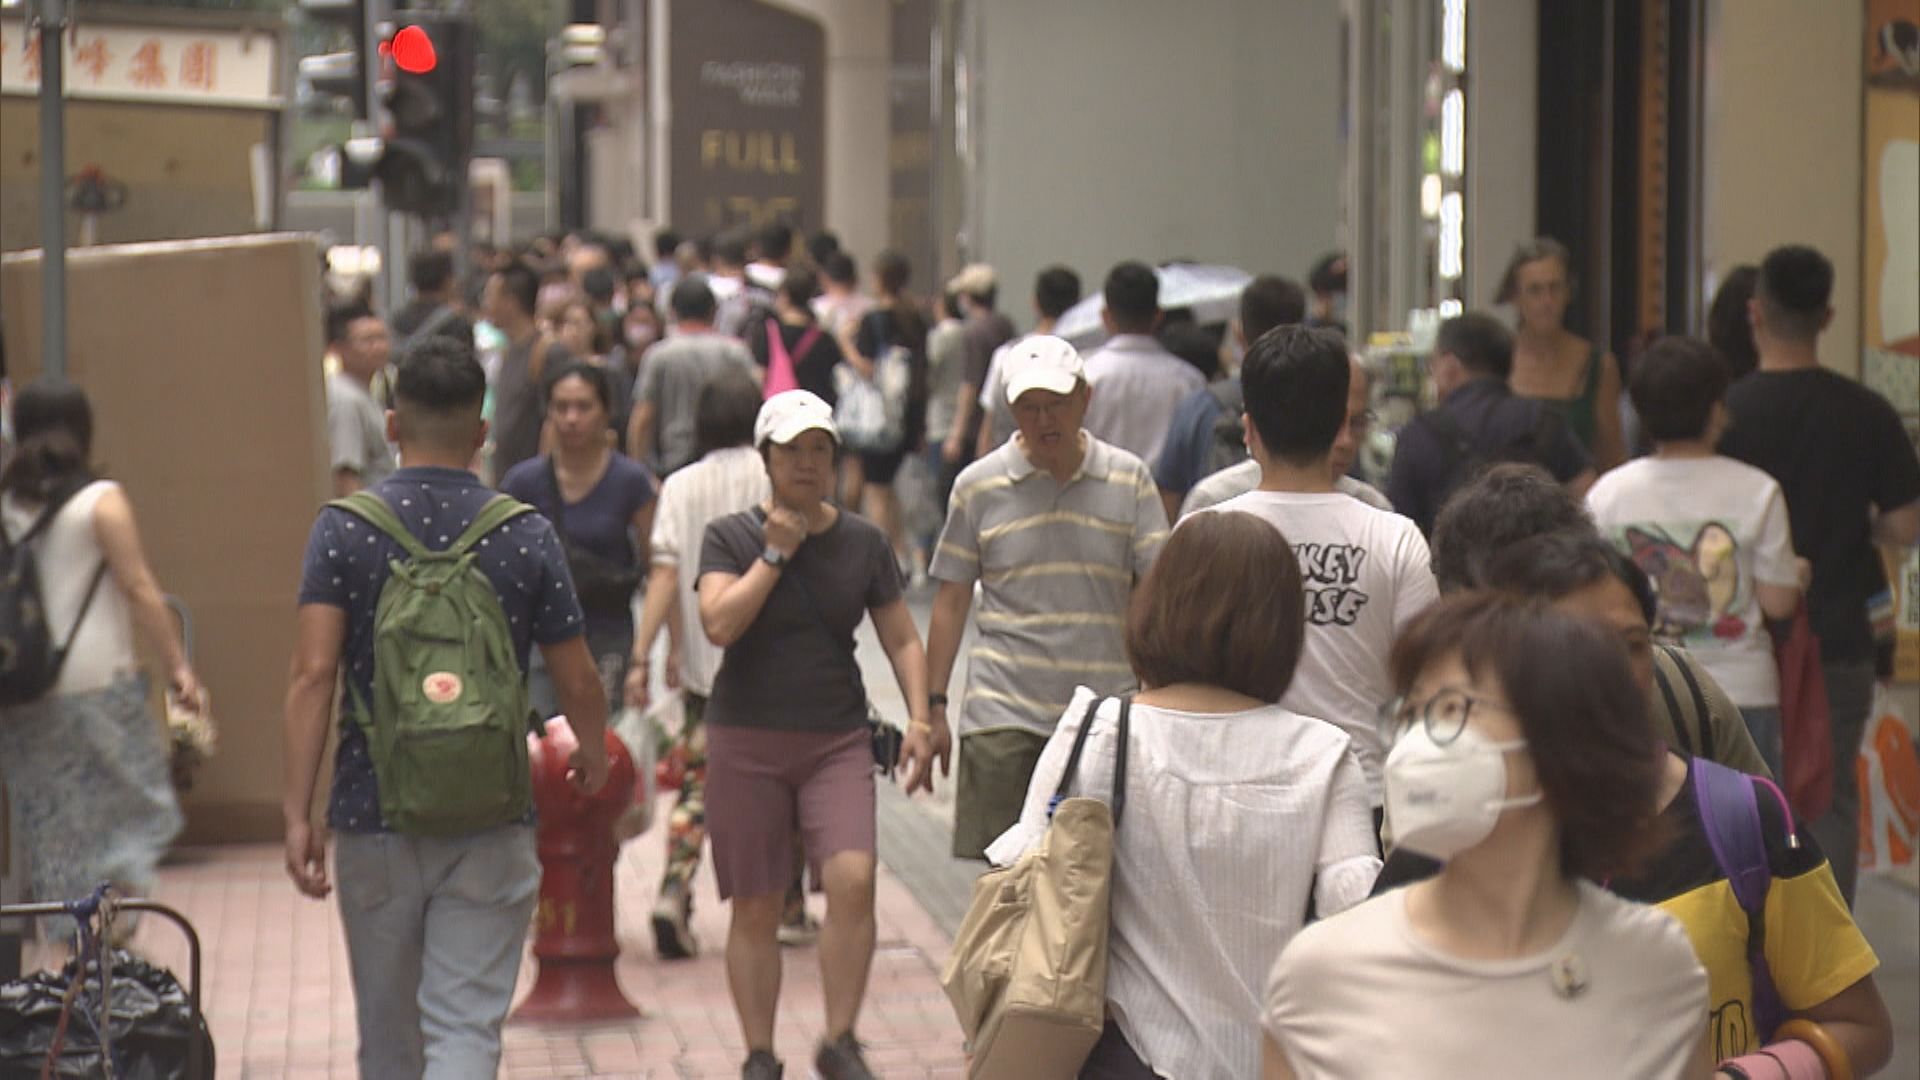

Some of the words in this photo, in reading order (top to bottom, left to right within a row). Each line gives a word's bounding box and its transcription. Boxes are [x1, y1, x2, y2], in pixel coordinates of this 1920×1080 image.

[0, 37, 217, 90] 峰集團
[701, 129, 799, 174] FULL
[1292, 543, 1367, 584] KEY
